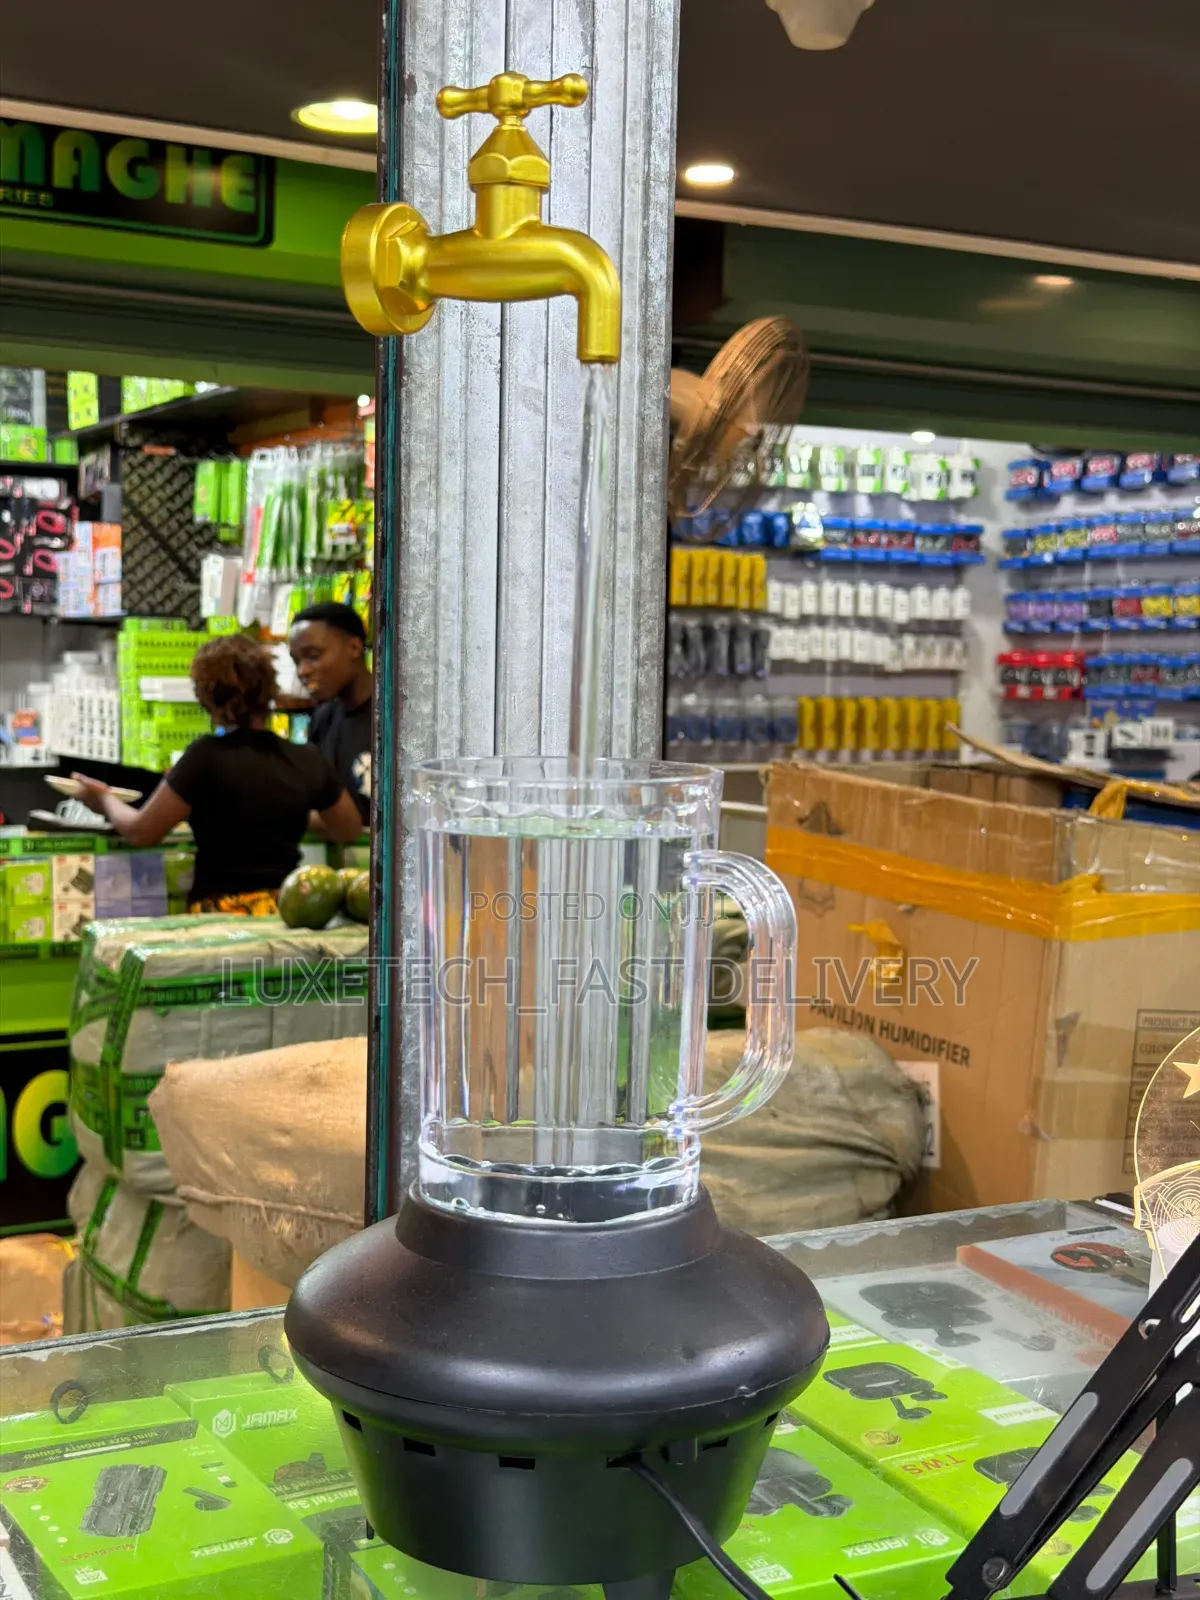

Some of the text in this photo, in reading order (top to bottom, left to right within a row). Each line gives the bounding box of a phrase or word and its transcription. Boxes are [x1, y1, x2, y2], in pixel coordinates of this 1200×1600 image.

[879, 1019, 971, 1069] HUMIDIFIER
[242, 1408, 299, 1427] JAMAX
[902, 1454, 965, 1476] TWS
[842, 1536, 909, 1557] JAMAX
